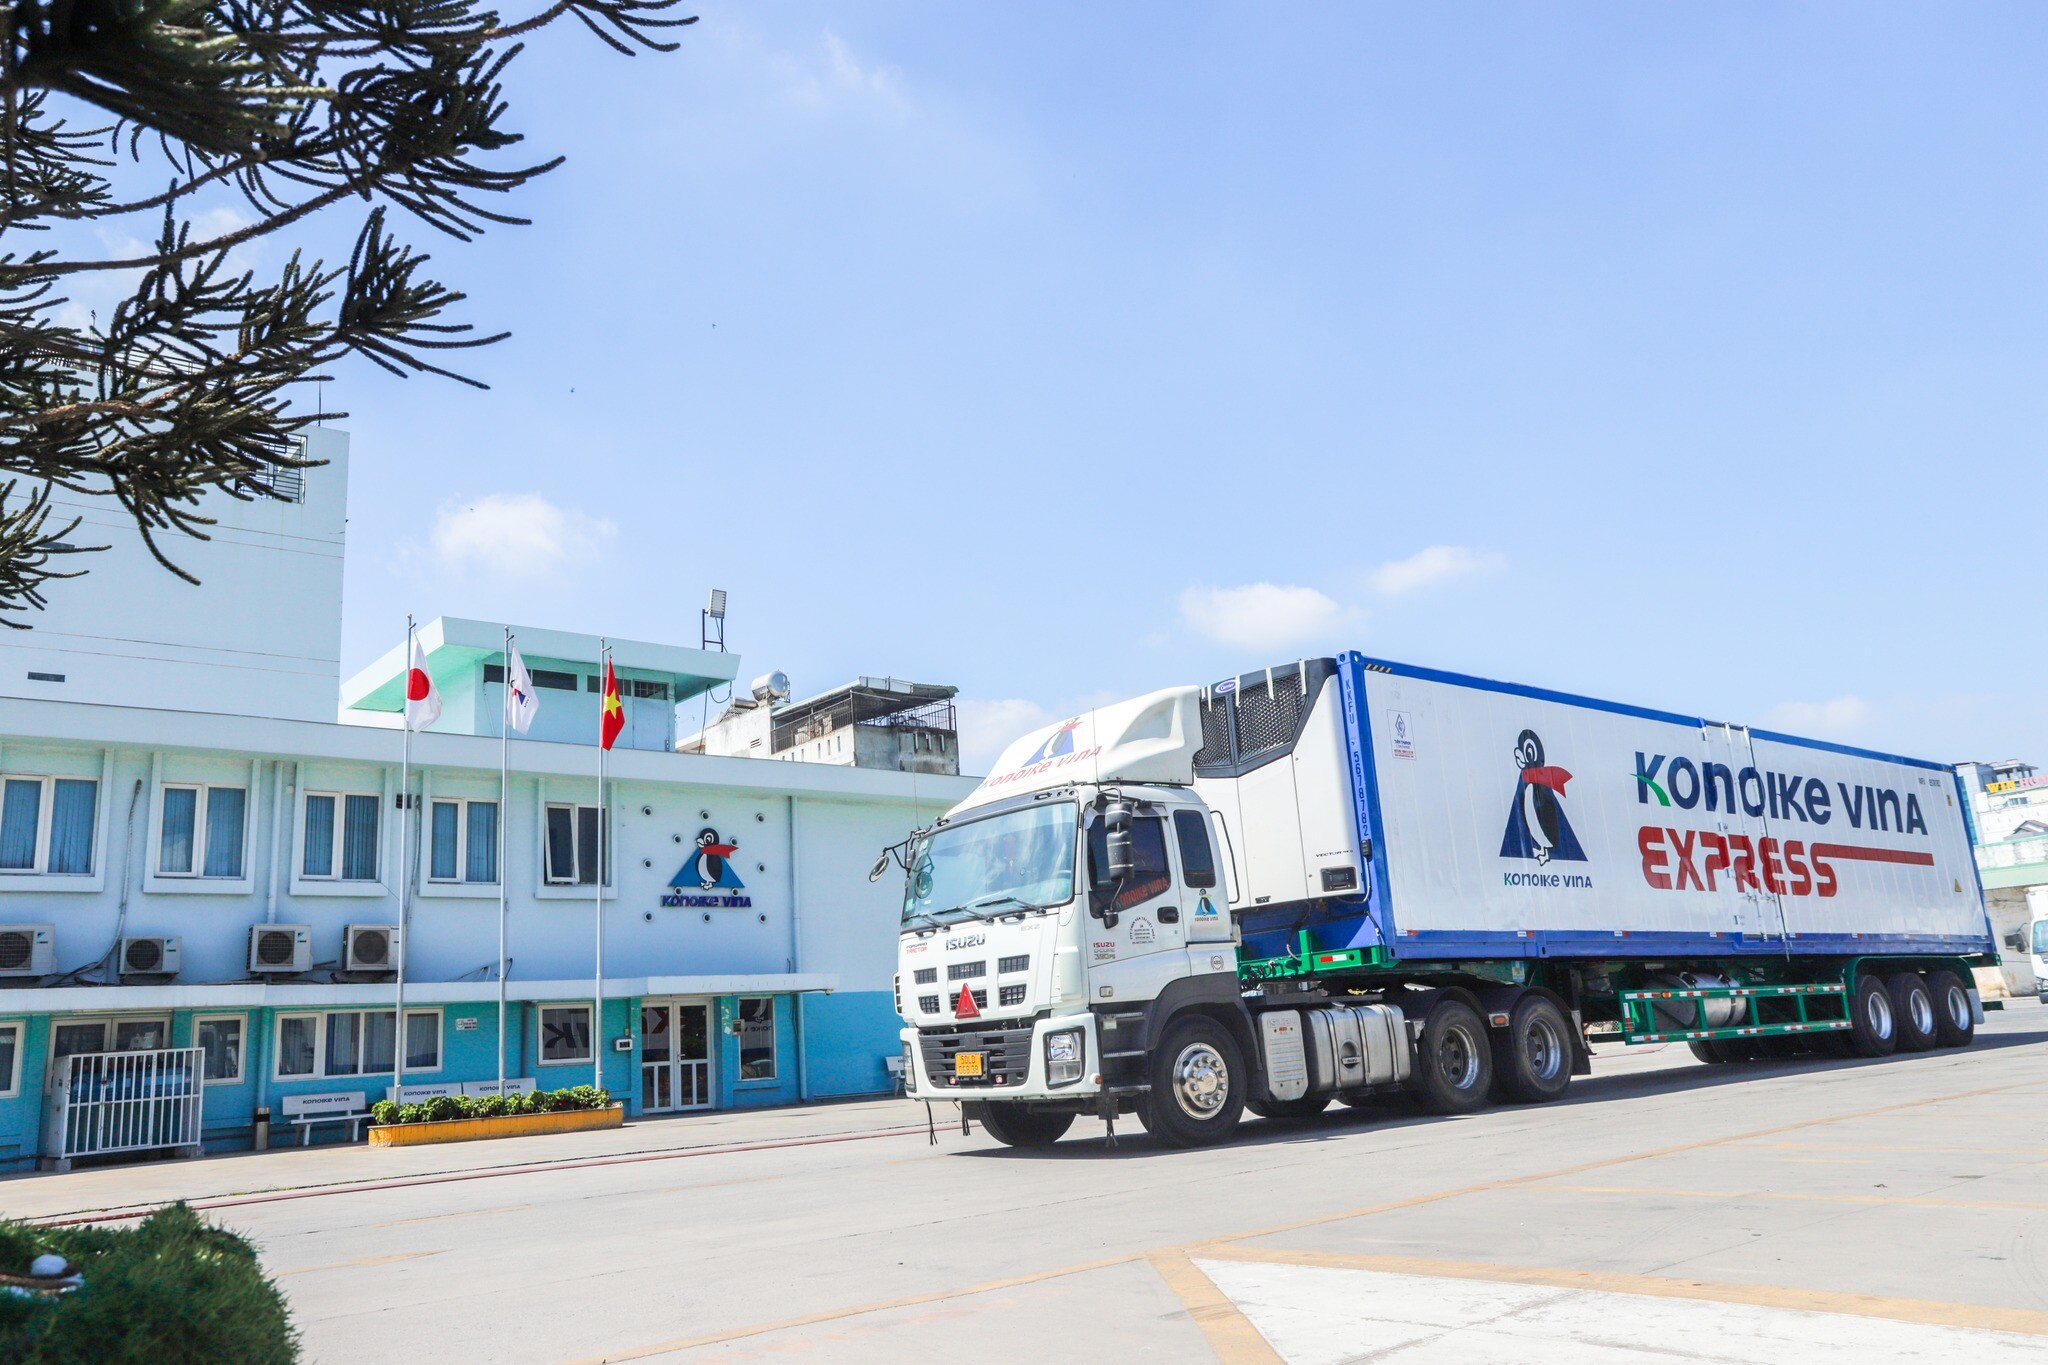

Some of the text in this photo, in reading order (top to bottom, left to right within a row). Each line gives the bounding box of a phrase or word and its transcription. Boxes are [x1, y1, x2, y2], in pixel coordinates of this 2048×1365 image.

[1345, 679, 1355, 725] KKFU
[1057, 745, 1102, 768] VINA
[1353, 751, 1369, 836] 5678782
[1629, 751, 1928, 836] KONOIKE VINA
[1638, 826, 1934, 897] EXPRESS
[1504, 872, 1593, 888] KONOIKE VINA
[660, 895, 752, 907] KONOIKE VINA
[946, 933, 986, 951] ISUZU
